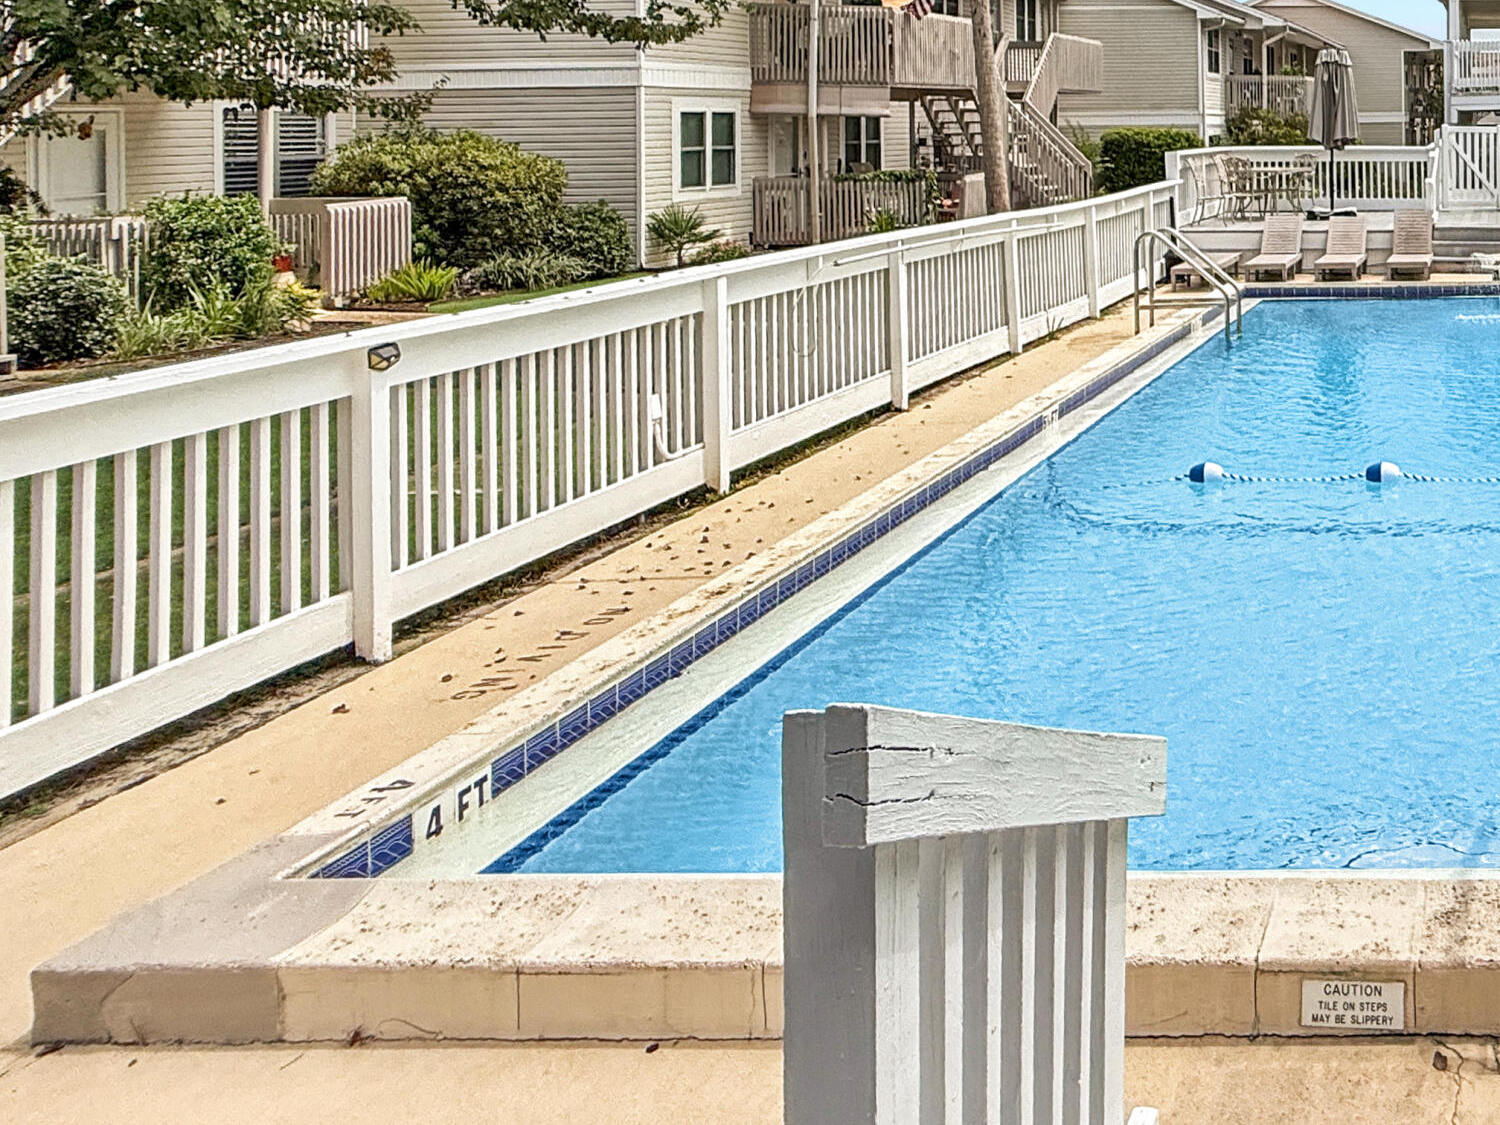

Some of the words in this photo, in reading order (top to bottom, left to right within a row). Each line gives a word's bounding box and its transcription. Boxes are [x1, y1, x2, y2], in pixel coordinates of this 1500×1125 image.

[426, 804, 443, 840] 4
[1323, 983, 1382, 997] CAUTION
[1318, 1001, 1338, 1011] TILE
[1343, 1001, 1355, 1011] ON
[1360, 1002, 1388, 1012] STEPS
[1312, 1014, 1330, 1023] MAY
[1335, 1014, 1346, 1024] BE
[1350, 1015, 1393, 1025] SLIPPERY
